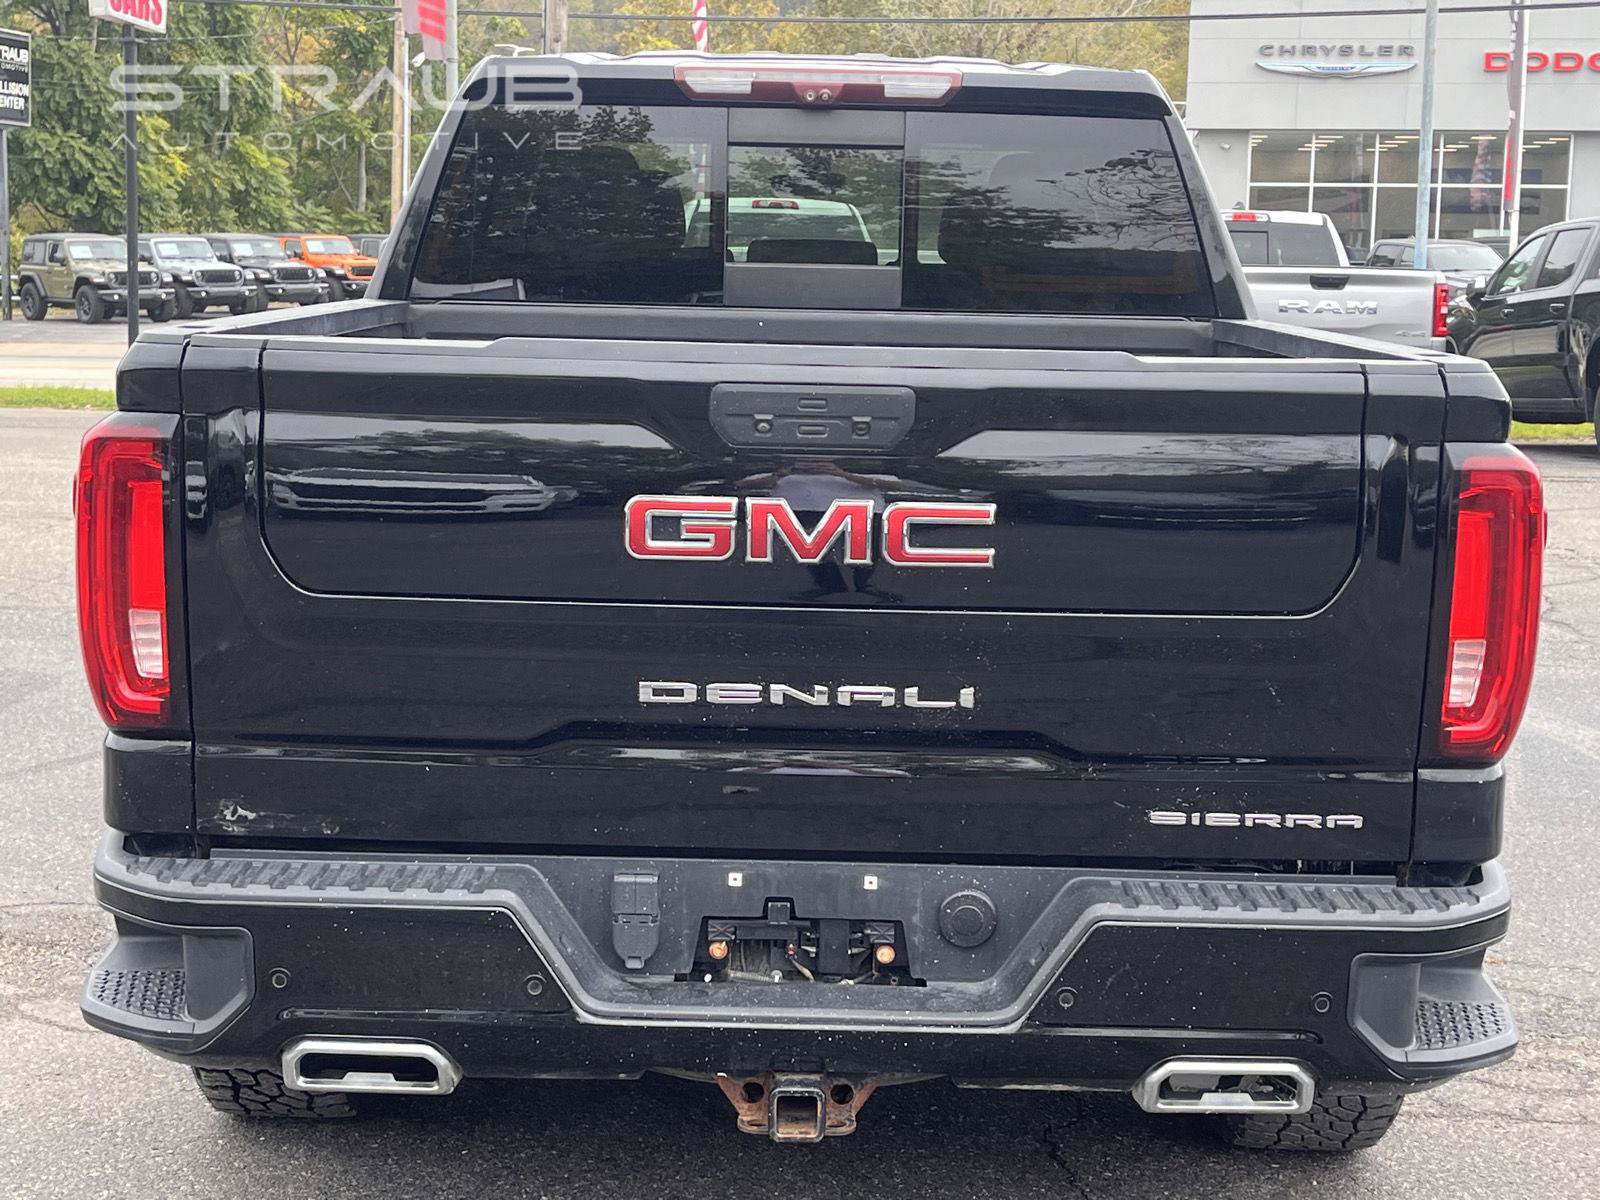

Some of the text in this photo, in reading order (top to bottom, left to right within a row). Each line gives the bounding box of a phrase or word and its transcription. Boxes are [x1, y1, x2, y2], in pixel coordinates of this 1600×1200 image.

[0, 45, 28, 62] RAUB
[1258, 44, 1415, 57] CHRYSLER
[1278, 299, 1378, 315] RAM
[624, 494, 997, 568] GMC
[638, 681, 975, 708] DENALI
[1149, 811, 1364, 829] SIERRA
